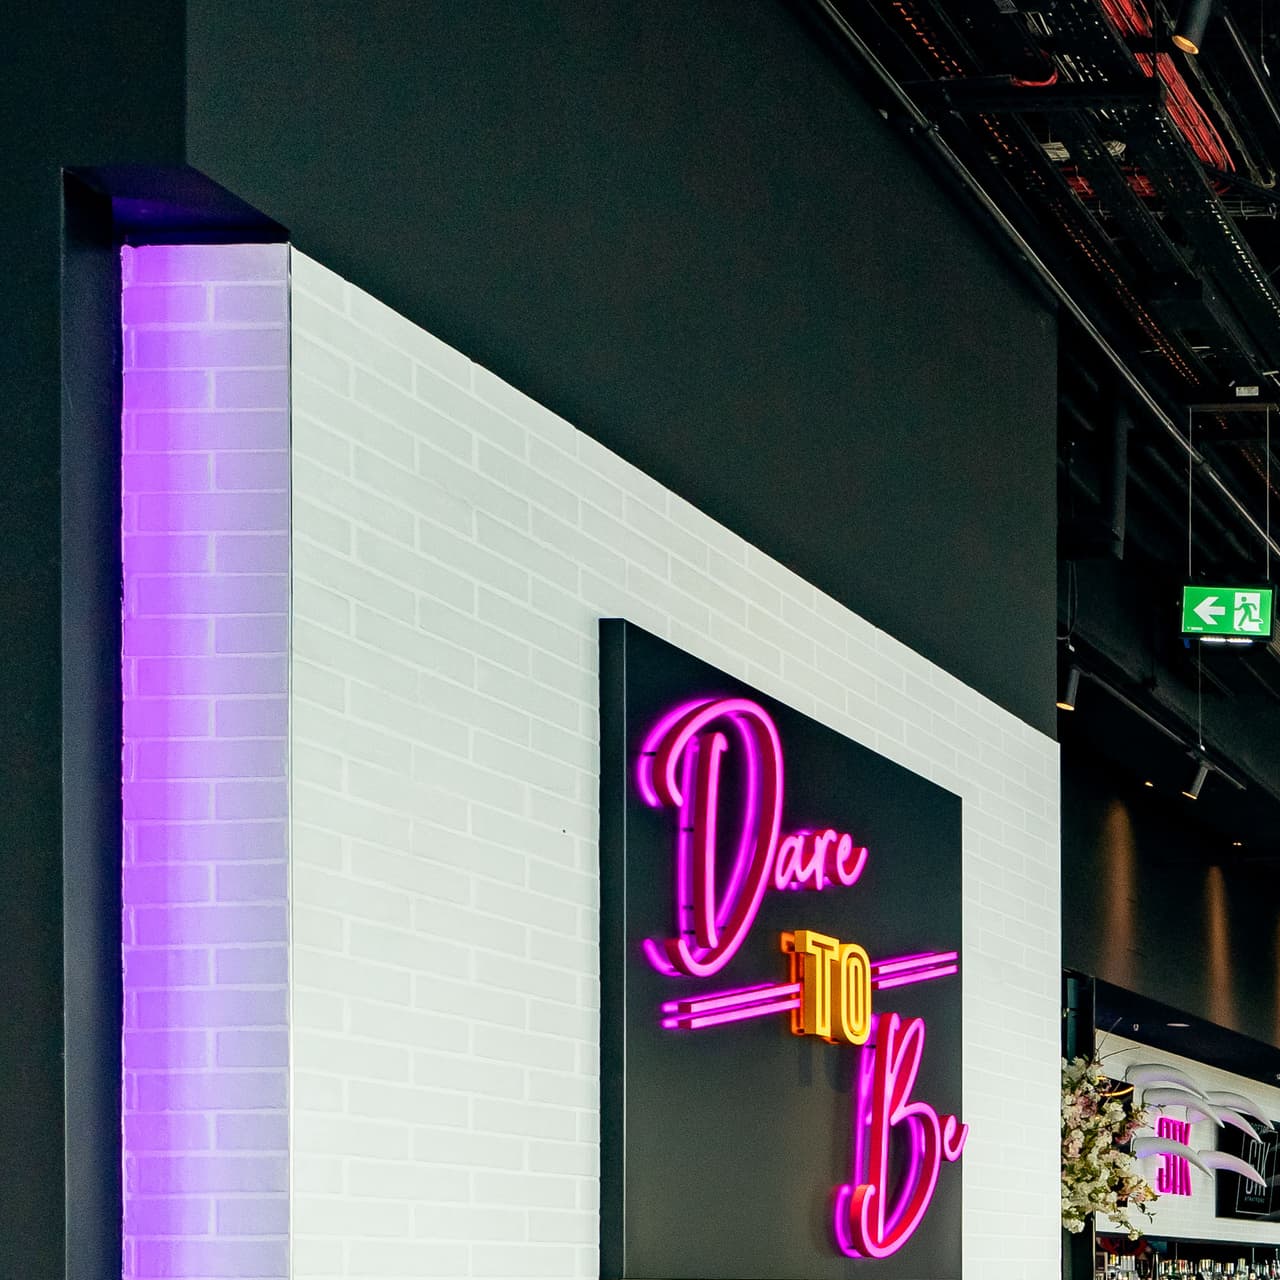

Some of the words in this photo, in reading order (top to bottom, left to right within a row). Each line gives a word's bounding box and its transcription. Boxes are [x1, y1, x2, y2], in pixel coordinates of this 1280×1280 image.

[638, 697, 868, 977] Dare
[781, 930, 872, 1046] TO
[834, 1012, 968, 1259] Be
